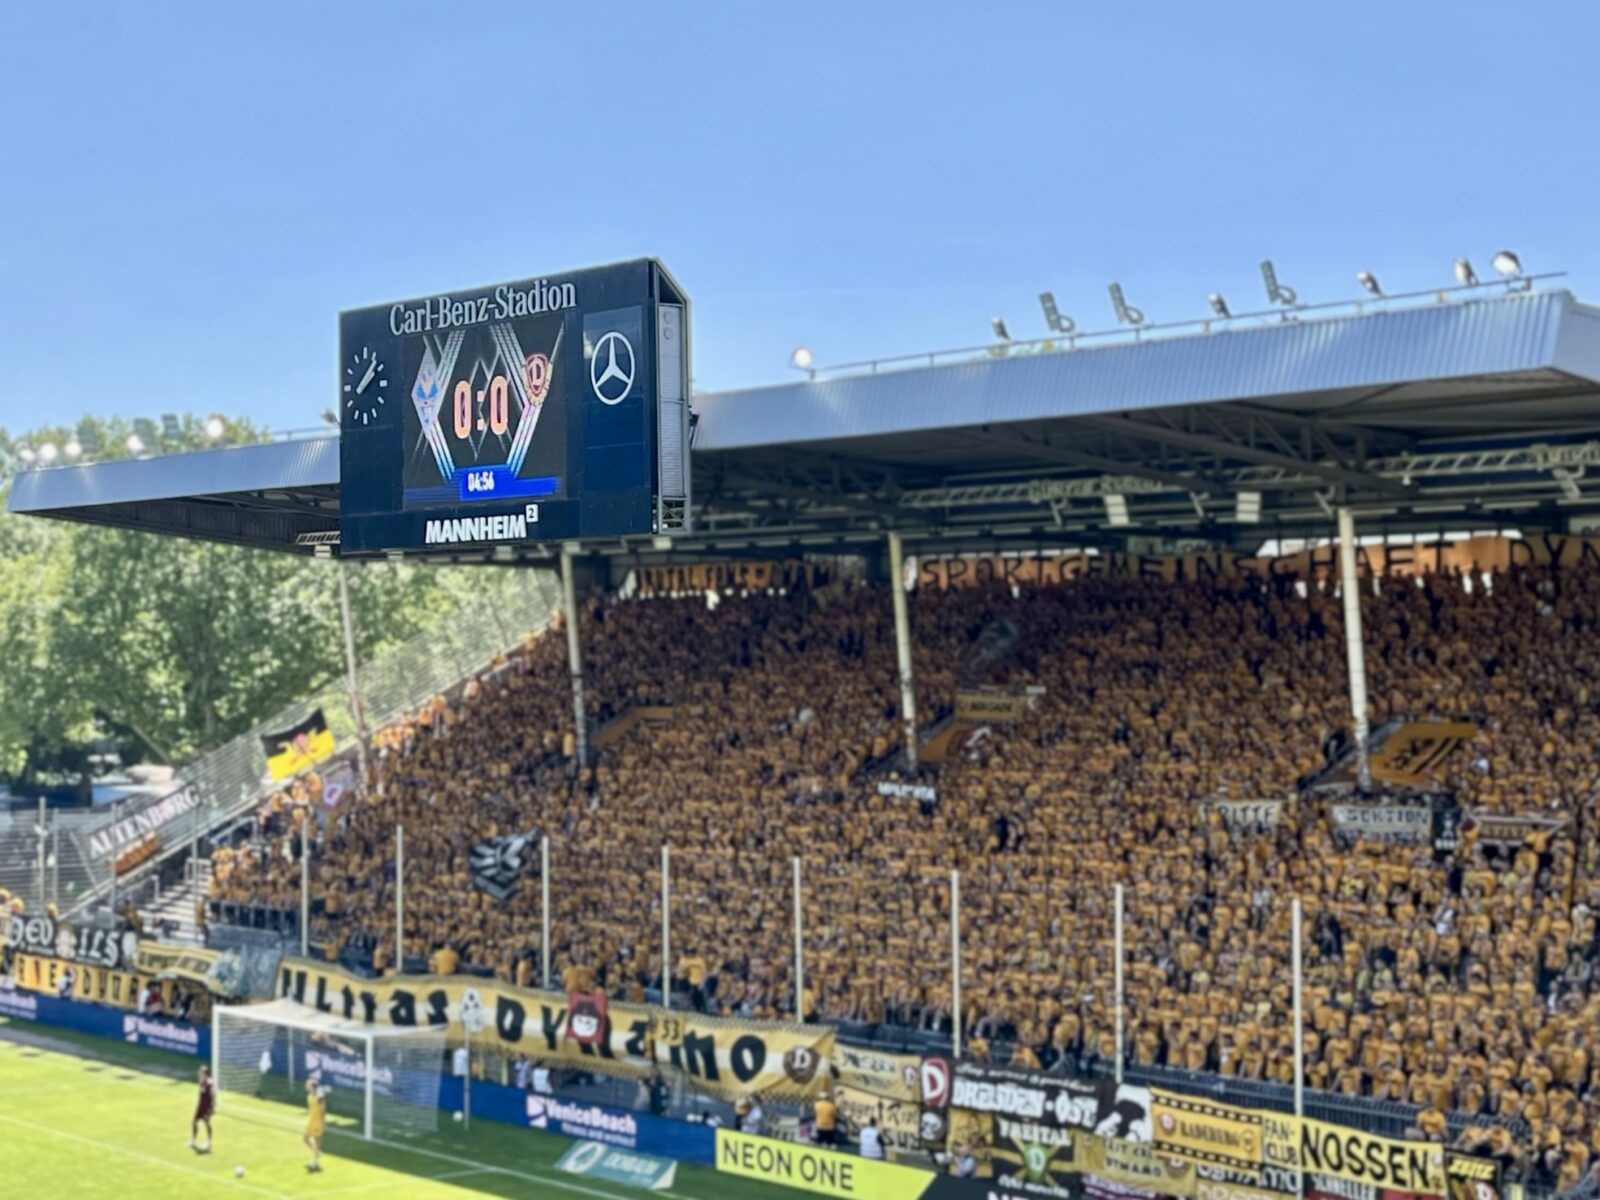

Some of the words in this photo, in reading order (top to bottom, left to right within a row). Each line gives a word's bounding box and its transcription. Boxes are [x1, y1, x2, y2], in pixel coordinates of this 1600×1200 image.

[389, 278, 577, 336] Carl-Benz-Stadion
[453, 375, 509, 439] 0:0
[425, 514, 527, 544] MANNHEIM
[723, 1137, 792, 1177] NEON
[799, 1154, 854, 1191] ONE
[1301, 1123, 1429, 1188] NOSSEN
